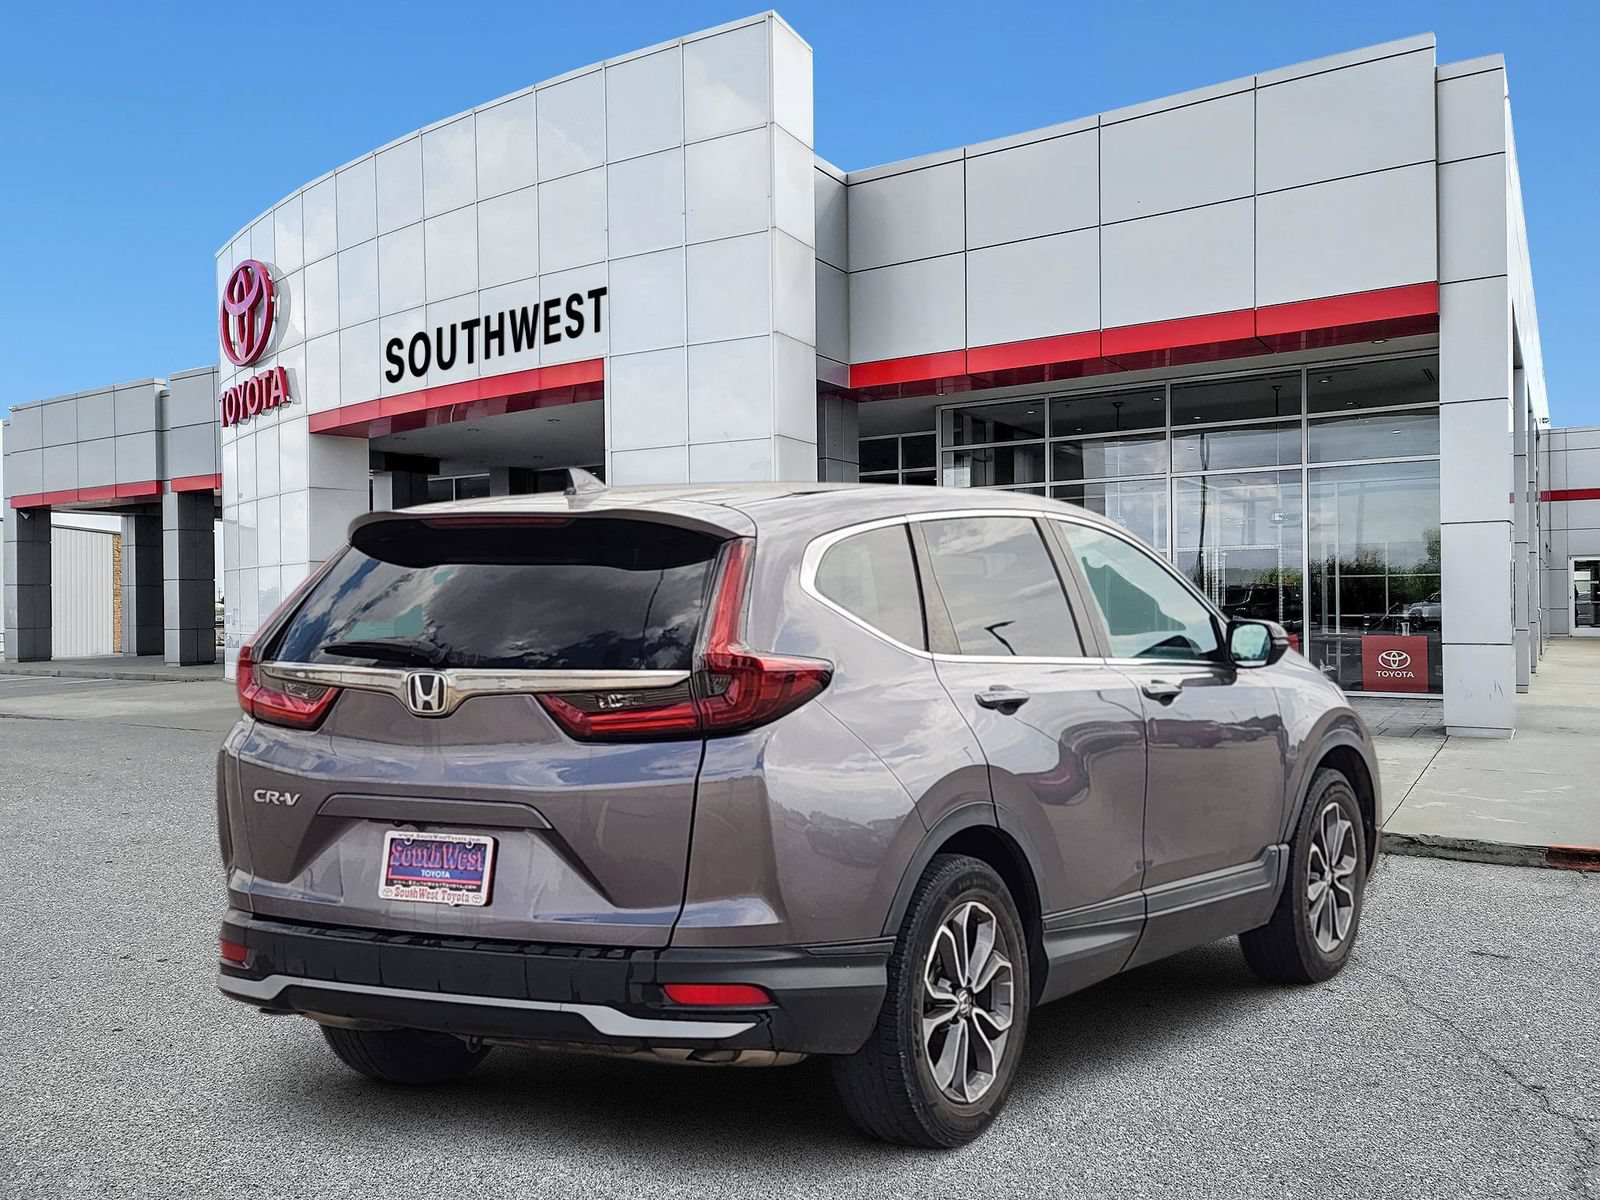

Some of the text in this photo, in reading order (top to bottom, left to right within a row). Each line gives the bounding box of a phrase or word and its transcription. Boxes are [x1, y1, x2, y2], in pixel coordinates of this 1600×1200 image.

[385, 287, 608, 384] SOUTHWEST
[219, 366, 290, 427] TOYOTA
[1376, 670, 1414, 678] TOYOTA
[253, 789, 300, 806] CR-V
[421, 869, 450, 878] TOYOTA
[442, 890, 470, 904] Toyota
